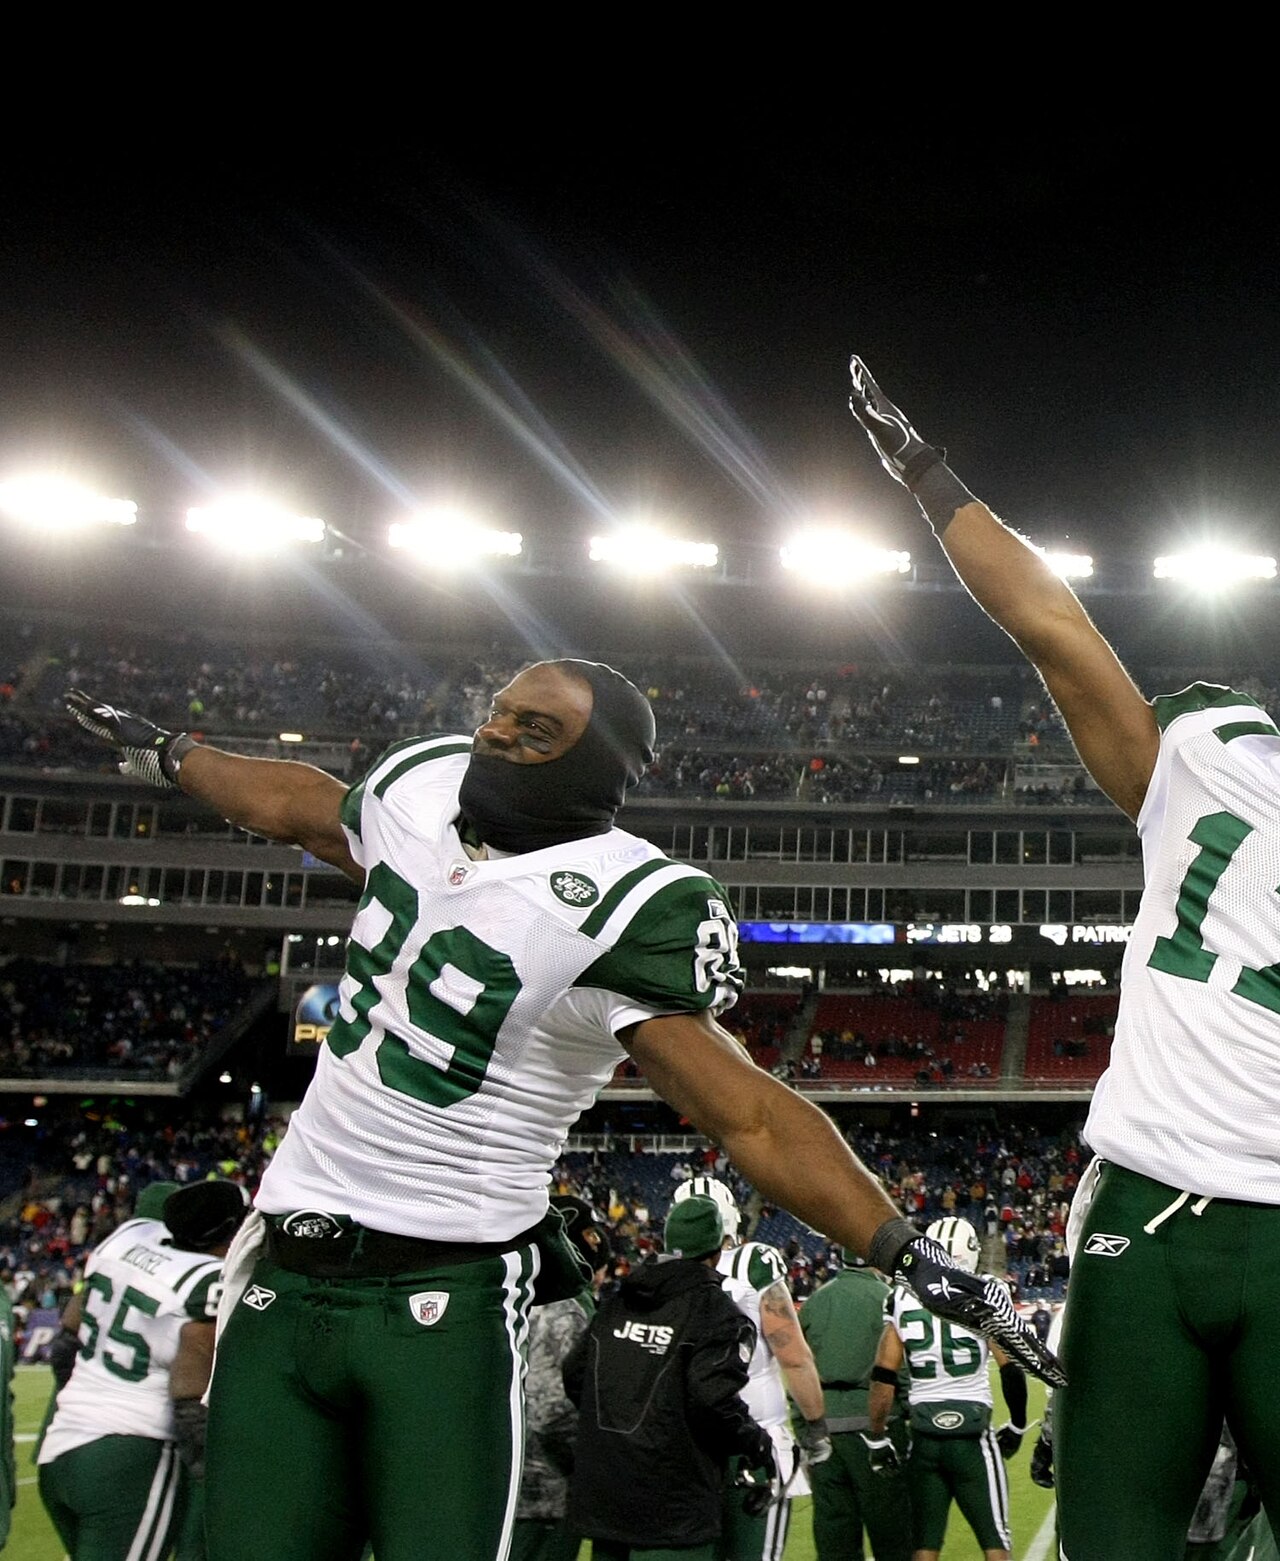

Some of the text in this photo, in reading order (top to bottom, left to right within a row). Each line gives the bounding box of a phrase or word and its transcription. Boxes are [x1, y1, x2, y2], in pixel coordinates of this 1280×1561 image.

[556, 875, 592, 900] JETS
[937, 924, 981, 942] JETS
[327, 860, 522, 1108] 89
[80, 1271, 161, 1382] 65
[613, 1321, 674, 1345] JETS
[900, 1309, 981, 1379] 26
